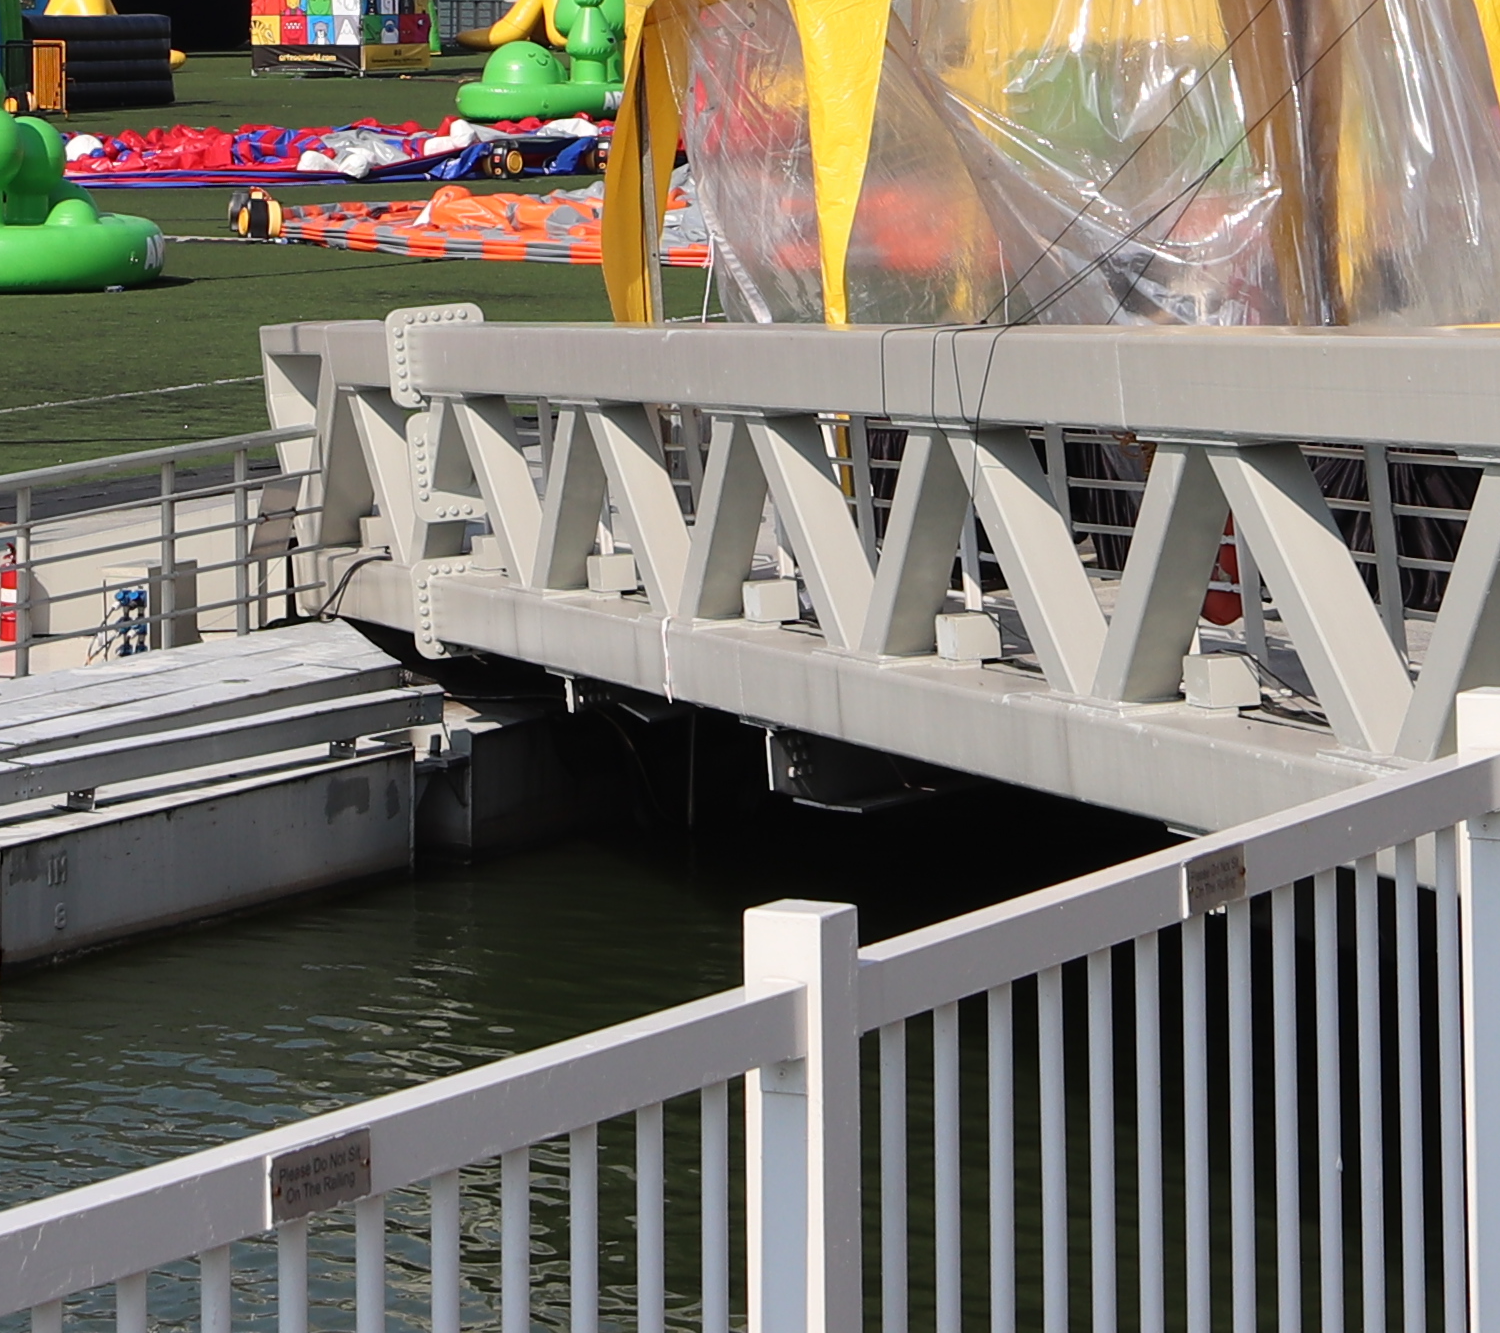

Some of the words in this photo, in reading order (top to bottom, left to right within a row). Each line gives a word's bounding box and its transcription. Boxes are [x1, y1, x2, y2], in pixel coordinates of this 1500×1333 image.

[280, 1163, 311, 1183] Please
[313, 1156, 328, 1174] Do
[330, 1152, 346, 1170] Not
[286, 1187, 300, 1204] On
[303, 1181, 320, 1198] The
[323, 1171, 356, 1193] Railing
